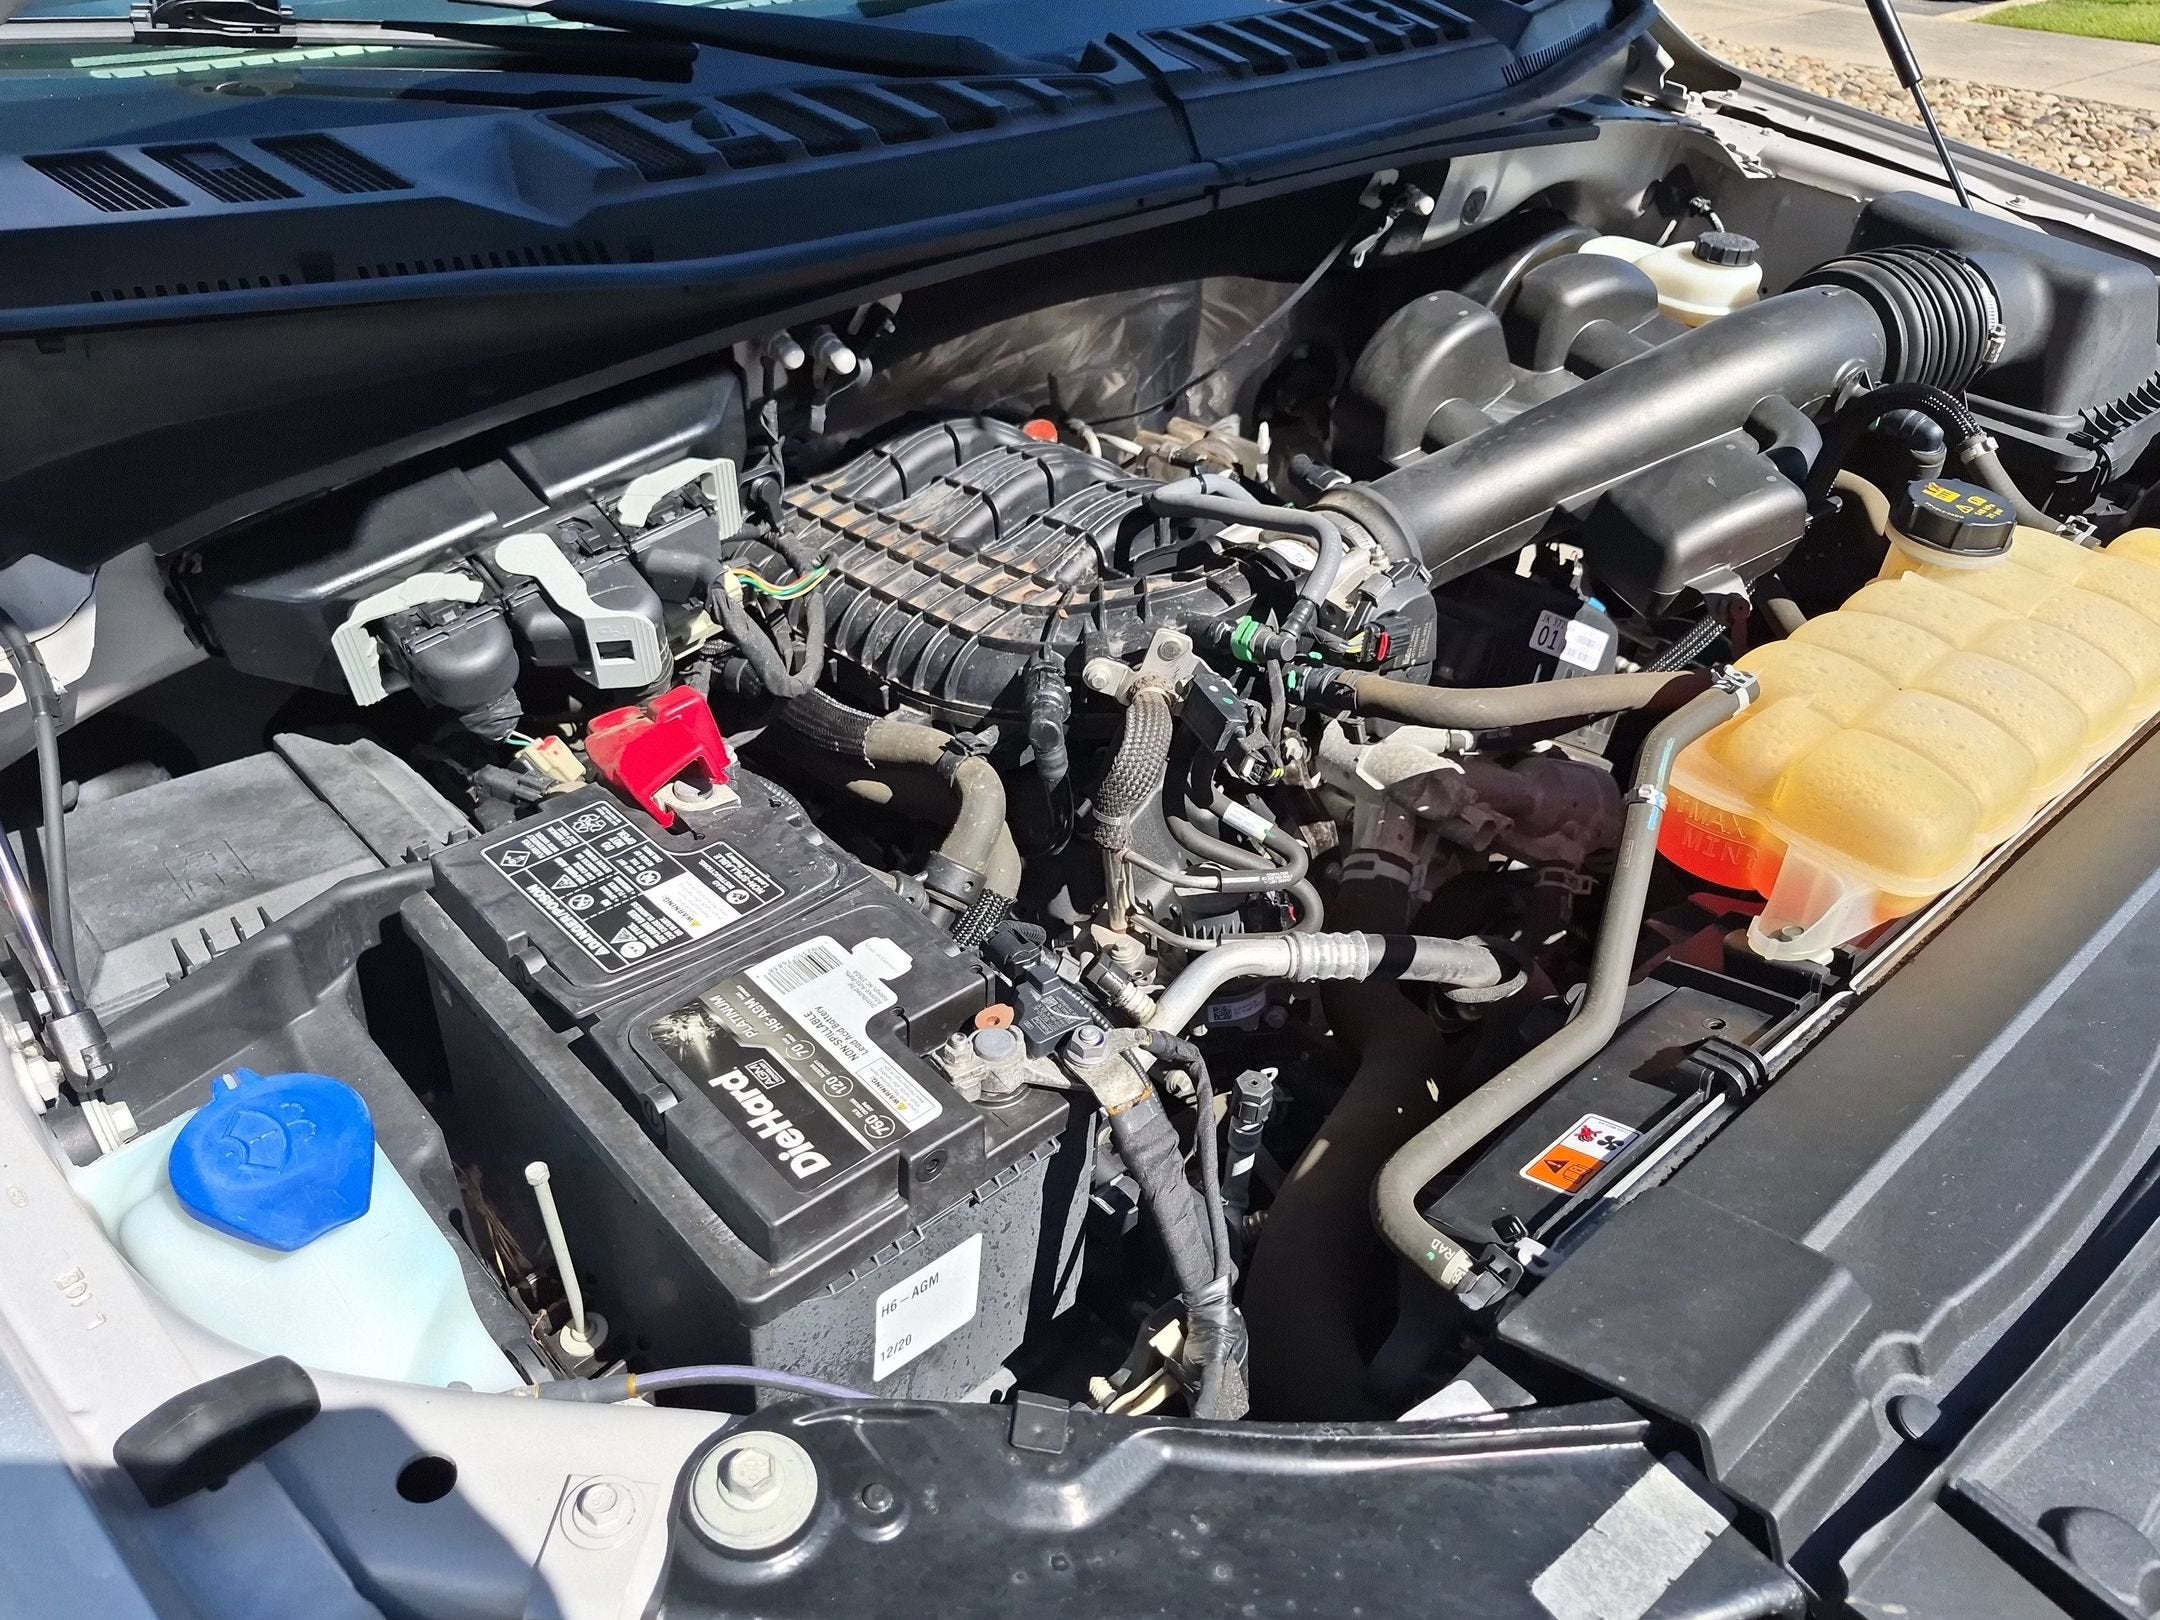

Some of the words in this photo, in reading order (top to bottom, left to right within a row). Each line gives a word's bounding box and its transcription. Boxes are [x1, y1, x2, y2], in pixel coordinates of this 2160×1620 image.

[1537, 625, 1560, 650] 01
[1682, 829, 1741, 864] MIN
[710, 852, 768, 894] NON-SPILLABLE
[709, 879, 729, 893] READ
[525, 883, 602, 950] DANGER/POISON
[708, 994, 759, 1038] PLATINUM
[743, 996, 784, 1032] H6-AGM
[813, 1004, 841, 1029] Battery
[802, 1009, 859, 1061] NON-SPILLABLE
[836, 1026, 854, 1041] Acid
[789, 1042, 809, 1057] 70
[849, 1039, 869, 1055] Lead
[749, 1063, 776, 1085] AGM
[823, 1074, 848, 1094] 120
[707, 1067, 832, 1179] DieHard
[863, 1113, 891, 1136] 760
[1429, 1238, 1455, 1260] RAD
[880, 1334, 912, 1362] 12/20
